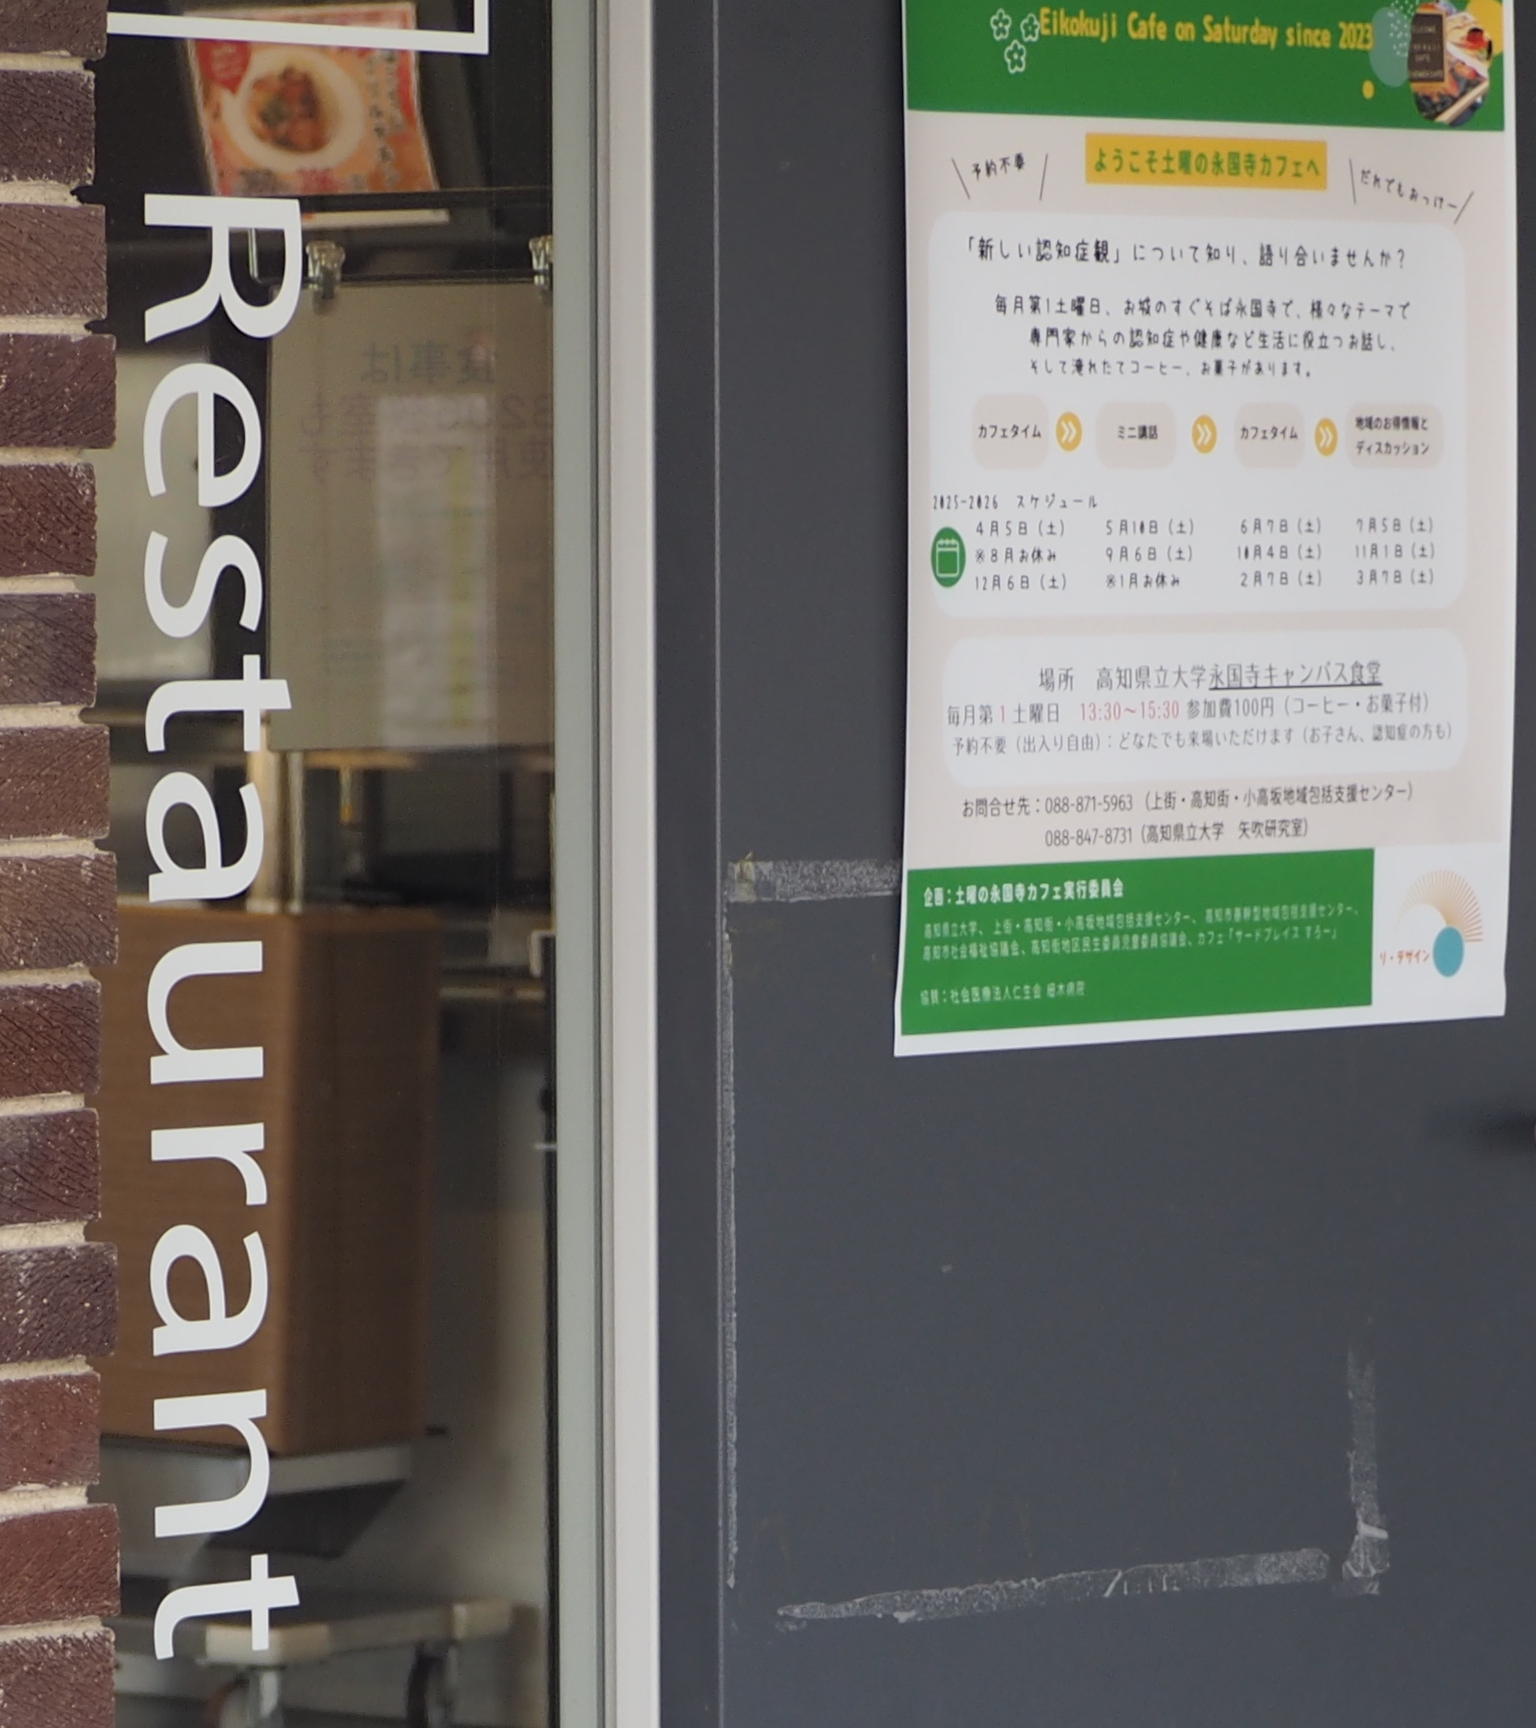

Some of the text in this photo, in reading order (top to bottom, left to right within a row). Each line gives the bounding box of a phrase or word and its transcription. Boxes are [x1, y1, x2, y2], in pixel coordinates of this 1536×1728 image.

[1039, 6, 1374, 50] Eikokuji Cafe on Saturday since 2023
[1094, 147, 1320, 178] ようこそ土曜の永国寺カフェへ
[977, 424, 1042, 440] カフェタイム
[1117, 424, 1159, 441] ミニ講話
[1240, 425, 1299, 441] カフェタイム
[1039, 666, 1074, 693] 場所
[143, 193, 303, 1660] Restaurant
